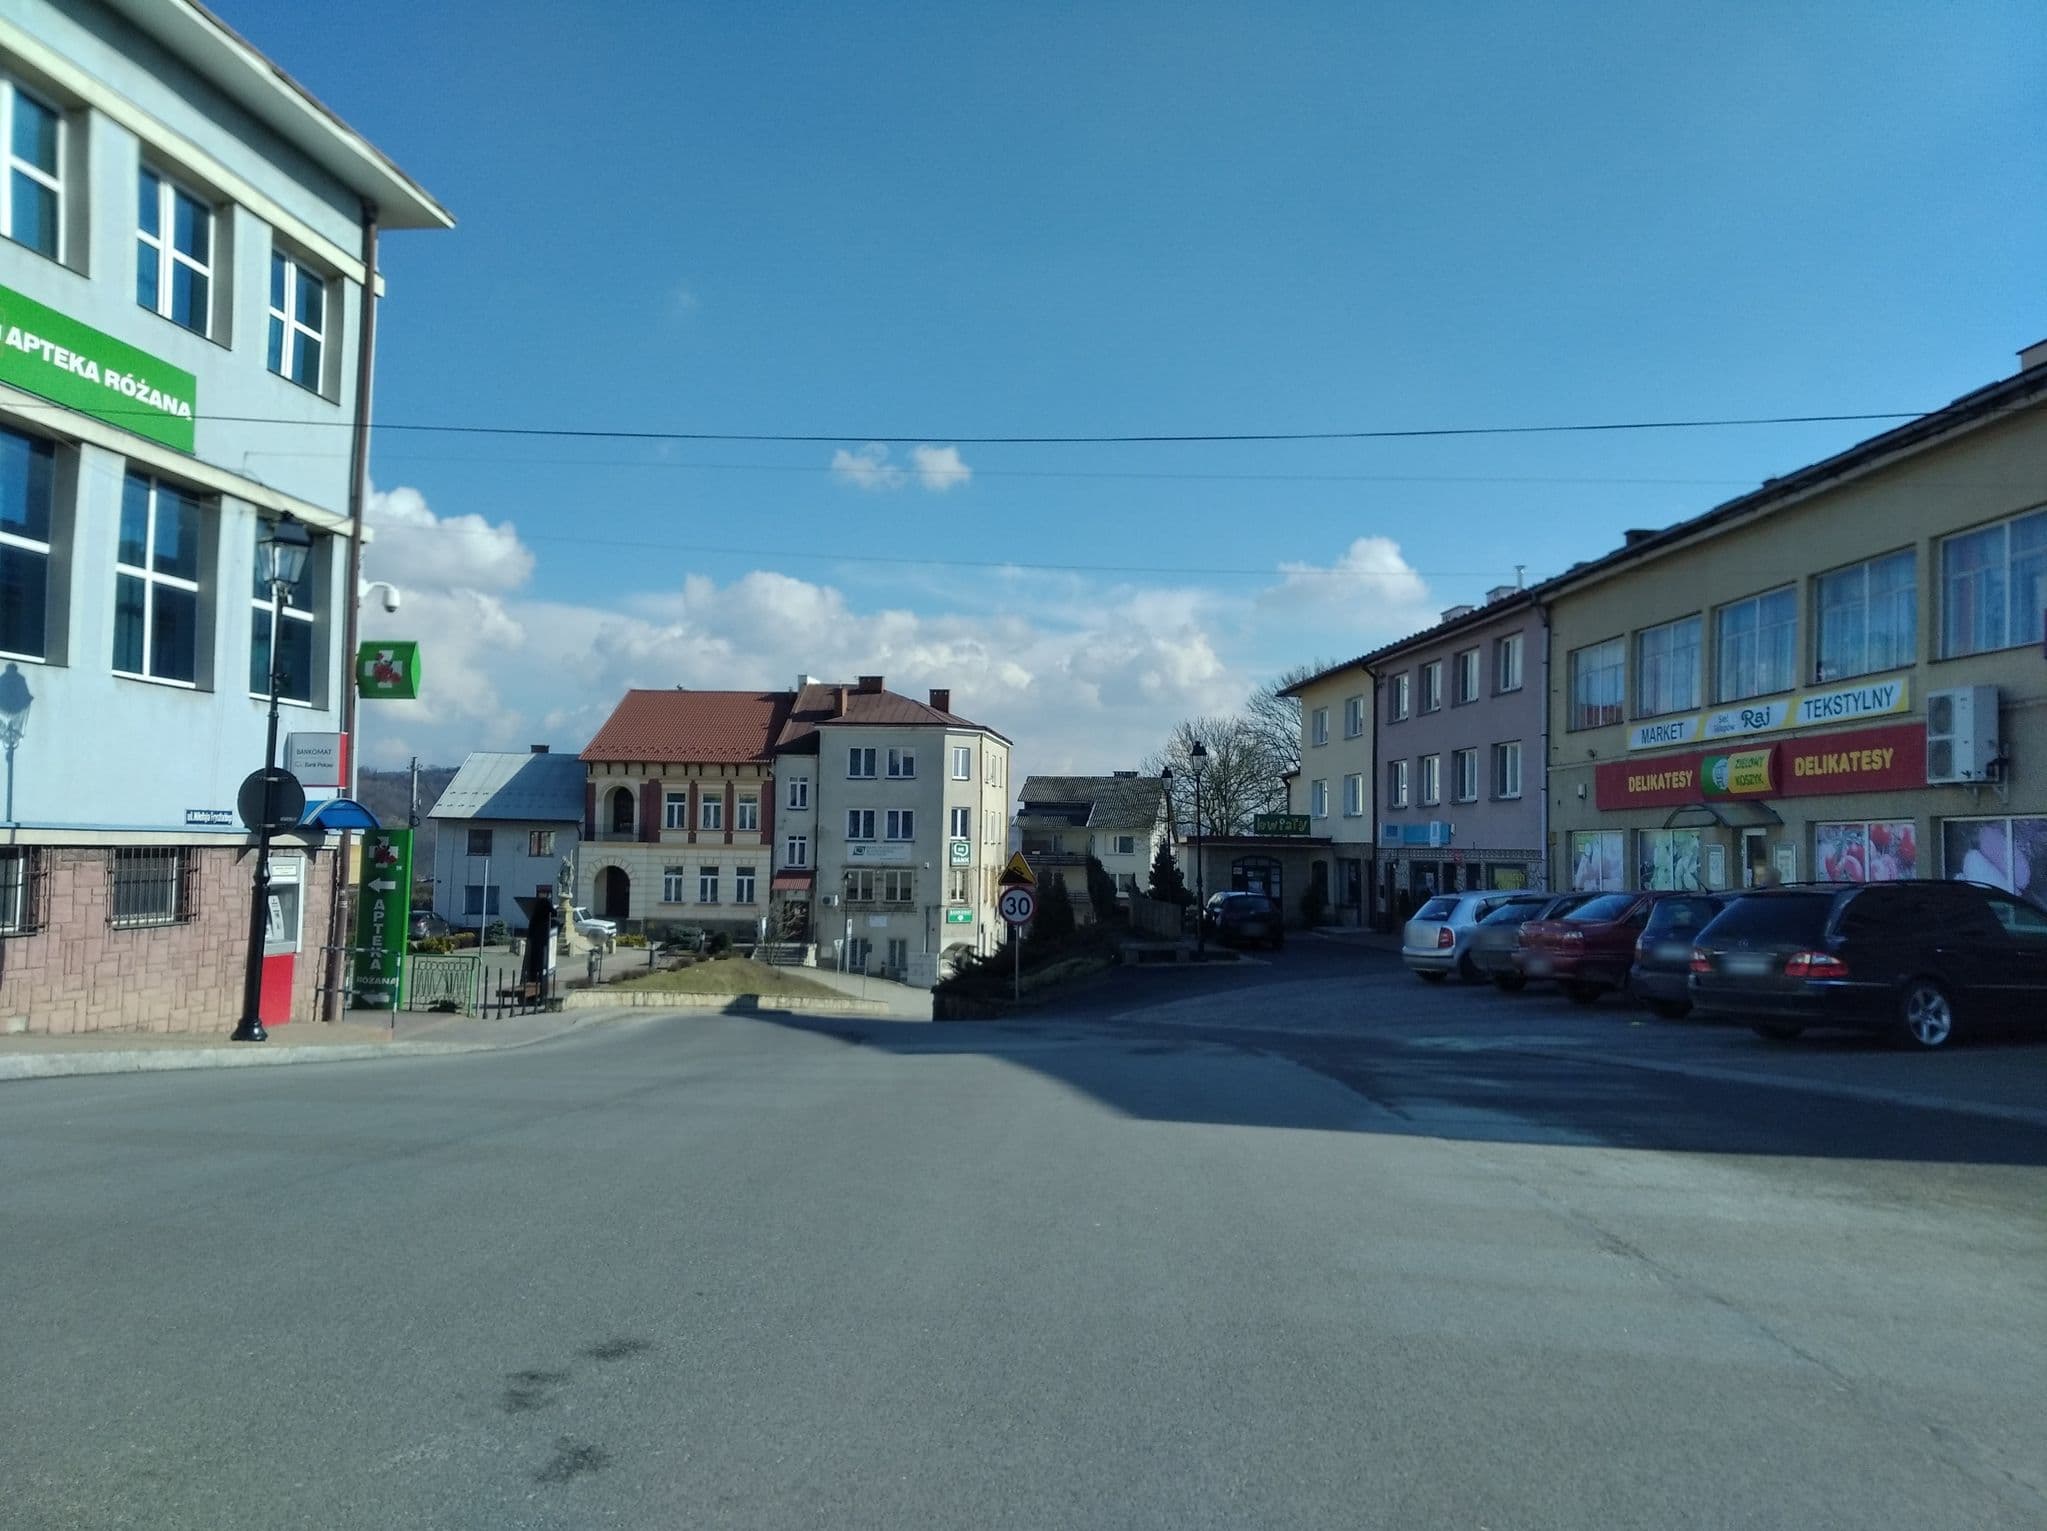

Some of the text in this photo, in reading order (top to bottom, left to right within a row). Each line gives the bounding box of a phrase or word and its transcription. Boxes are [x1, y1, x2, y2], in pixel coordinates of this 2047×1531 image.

[5, 326, 193, 421] APTEKA RÓŻANA
[1804, 685, 1894, 719] TEKSTYLNY
[1741, 706, 1770, 729] Raj
[1641, 722, 1684, 744] MARKET
[296, 748, 332, 756] BANKOMAT
[1793, 747, 1894, 776] DELIKATESY
[1628, 769, 1693, 792] DELIKATESY
[1005, 896, 1030, 915] 30
[370, 898, 385, 969] APTEKA
